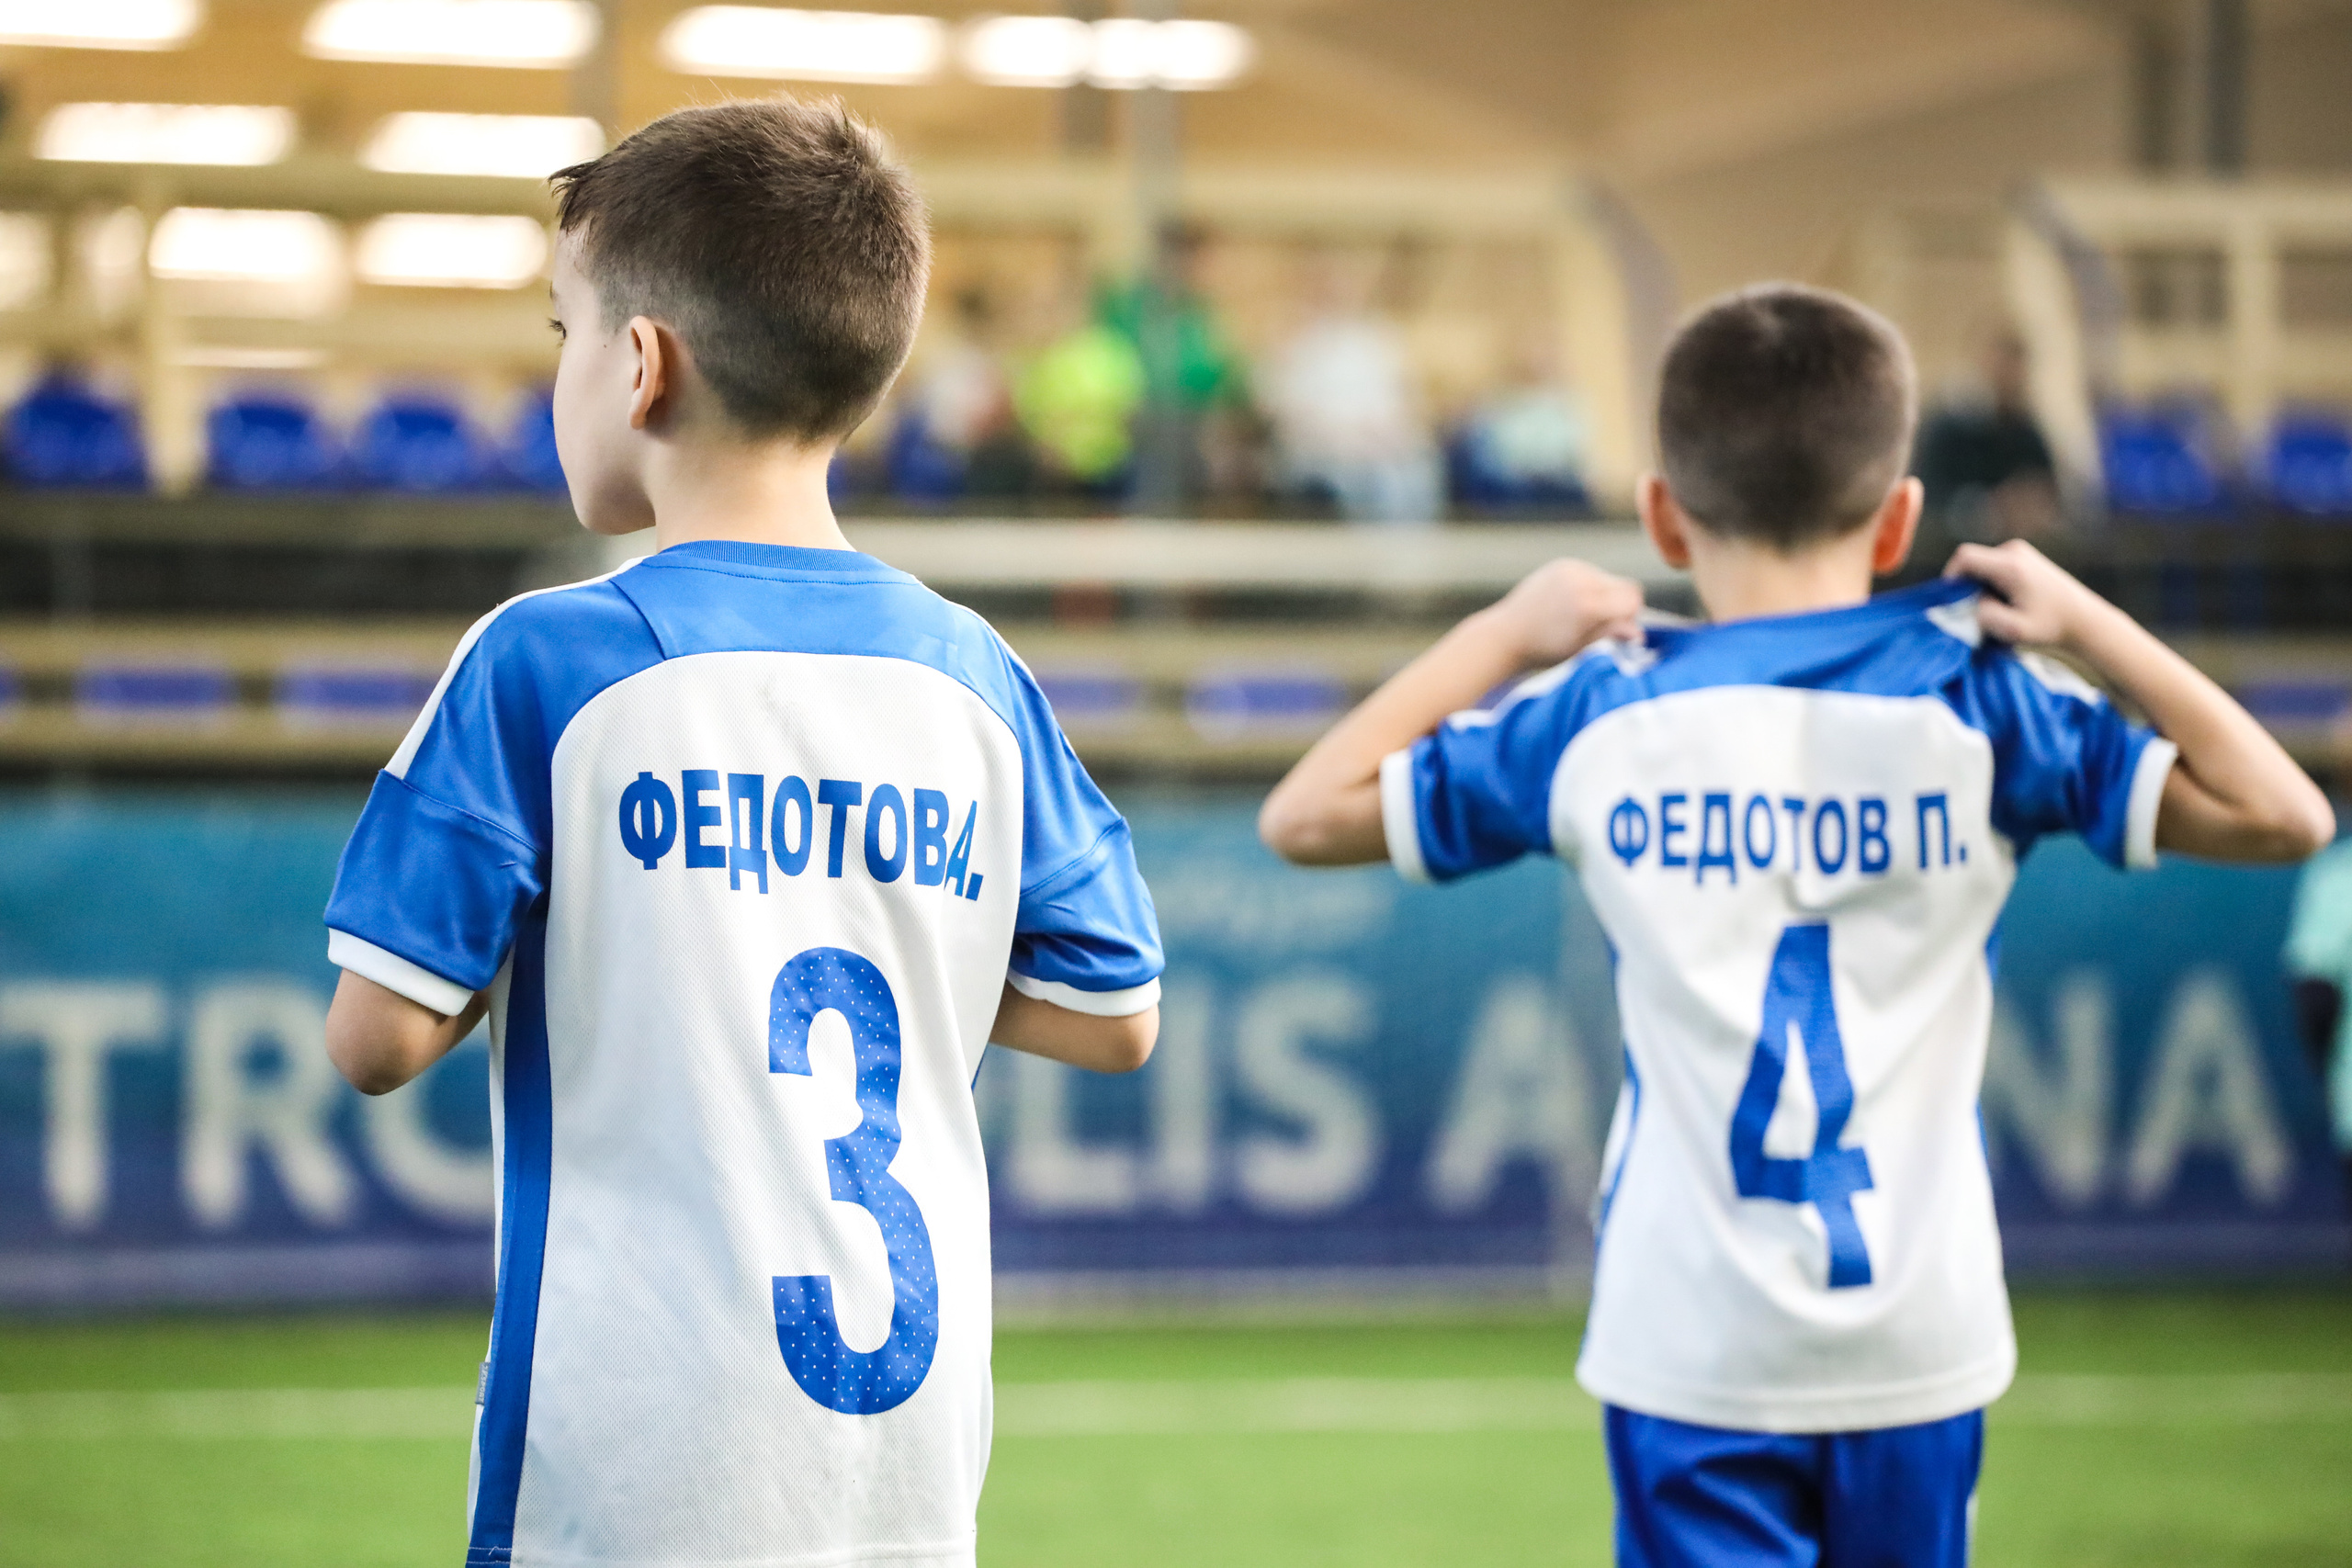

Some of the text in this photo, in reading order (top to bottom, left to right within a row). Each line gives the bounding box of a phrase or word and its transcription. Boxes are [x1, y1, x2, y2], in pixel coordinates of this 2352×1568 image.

[1609, 789, 1967, 885] ФЕДОТОВ П.
[769, 947, 938, 1416] 3
[1730, 922, 1874, 1291] 4
